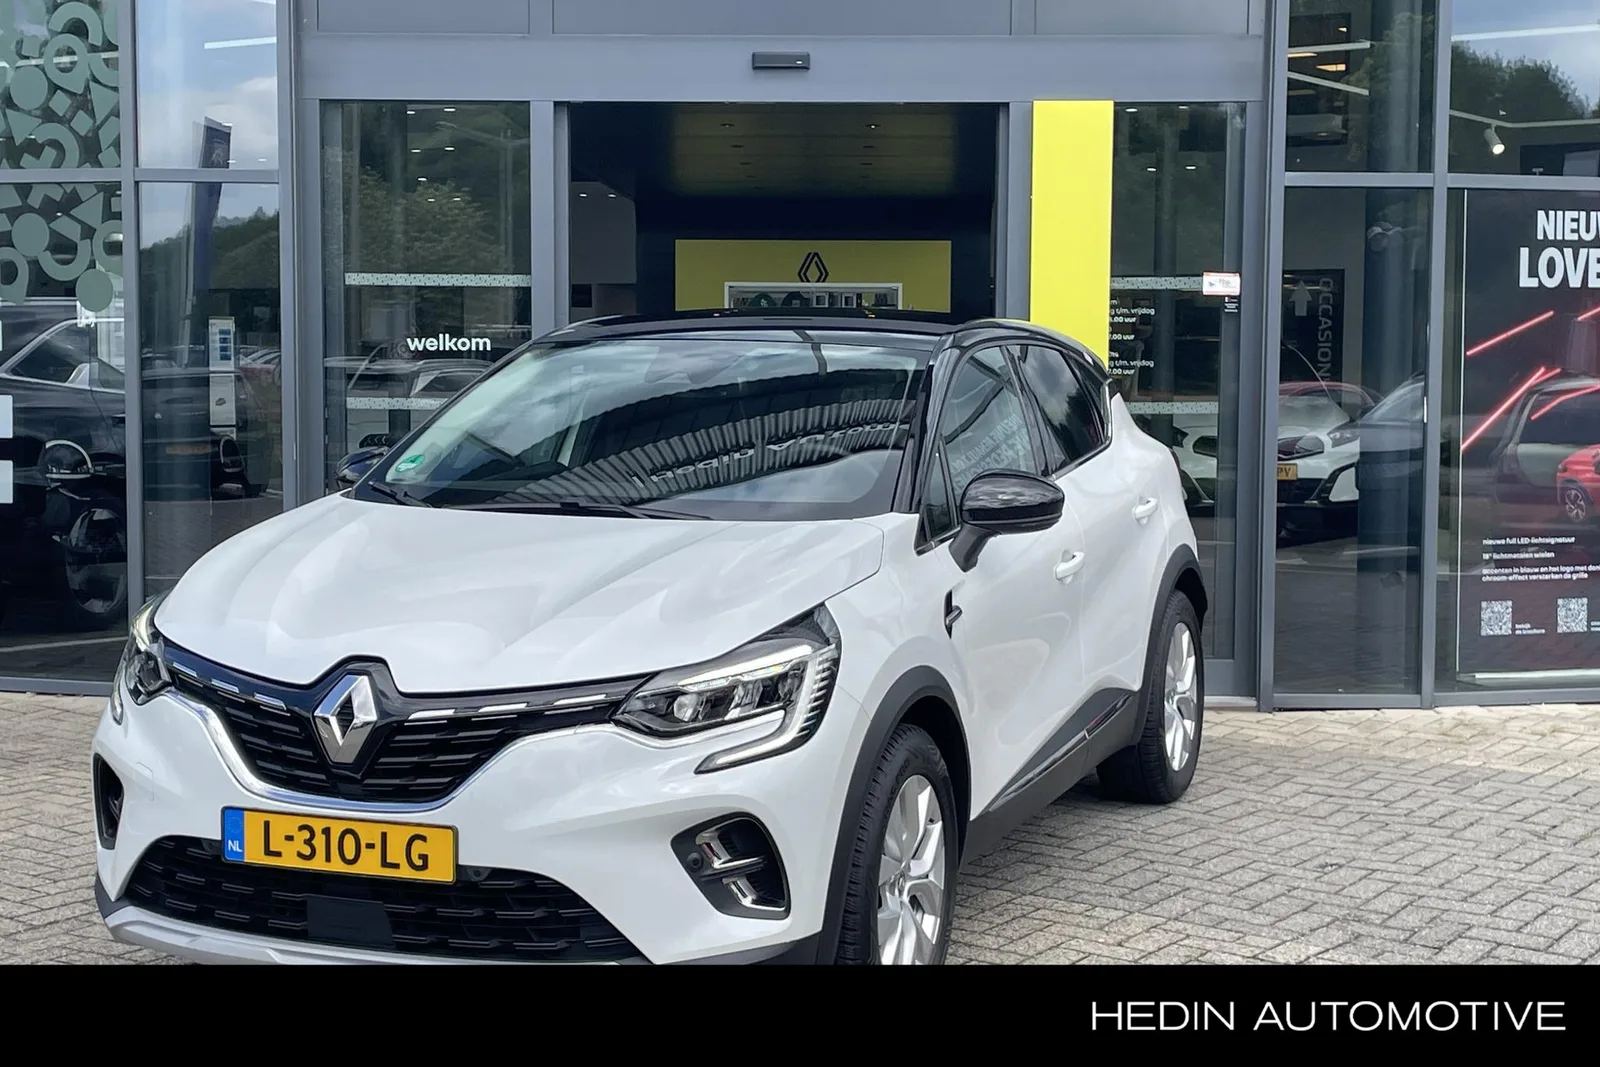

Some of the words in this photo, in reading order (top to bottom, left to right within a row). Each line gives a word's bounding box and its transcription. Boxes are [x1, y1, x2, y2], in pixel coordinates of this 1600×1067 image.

[1537, 210, 1600, 241] NIEU
[1131, 307, 1155, 315] vrijdag
[406, 333, 491, 351] welkom
[1130, 359, 1154, 368] vrijdag
[1520, 565, 1539, 573] blauw
[228, 840, 242, 853] NL
[263, 820, 429, 872] L-310-LG
